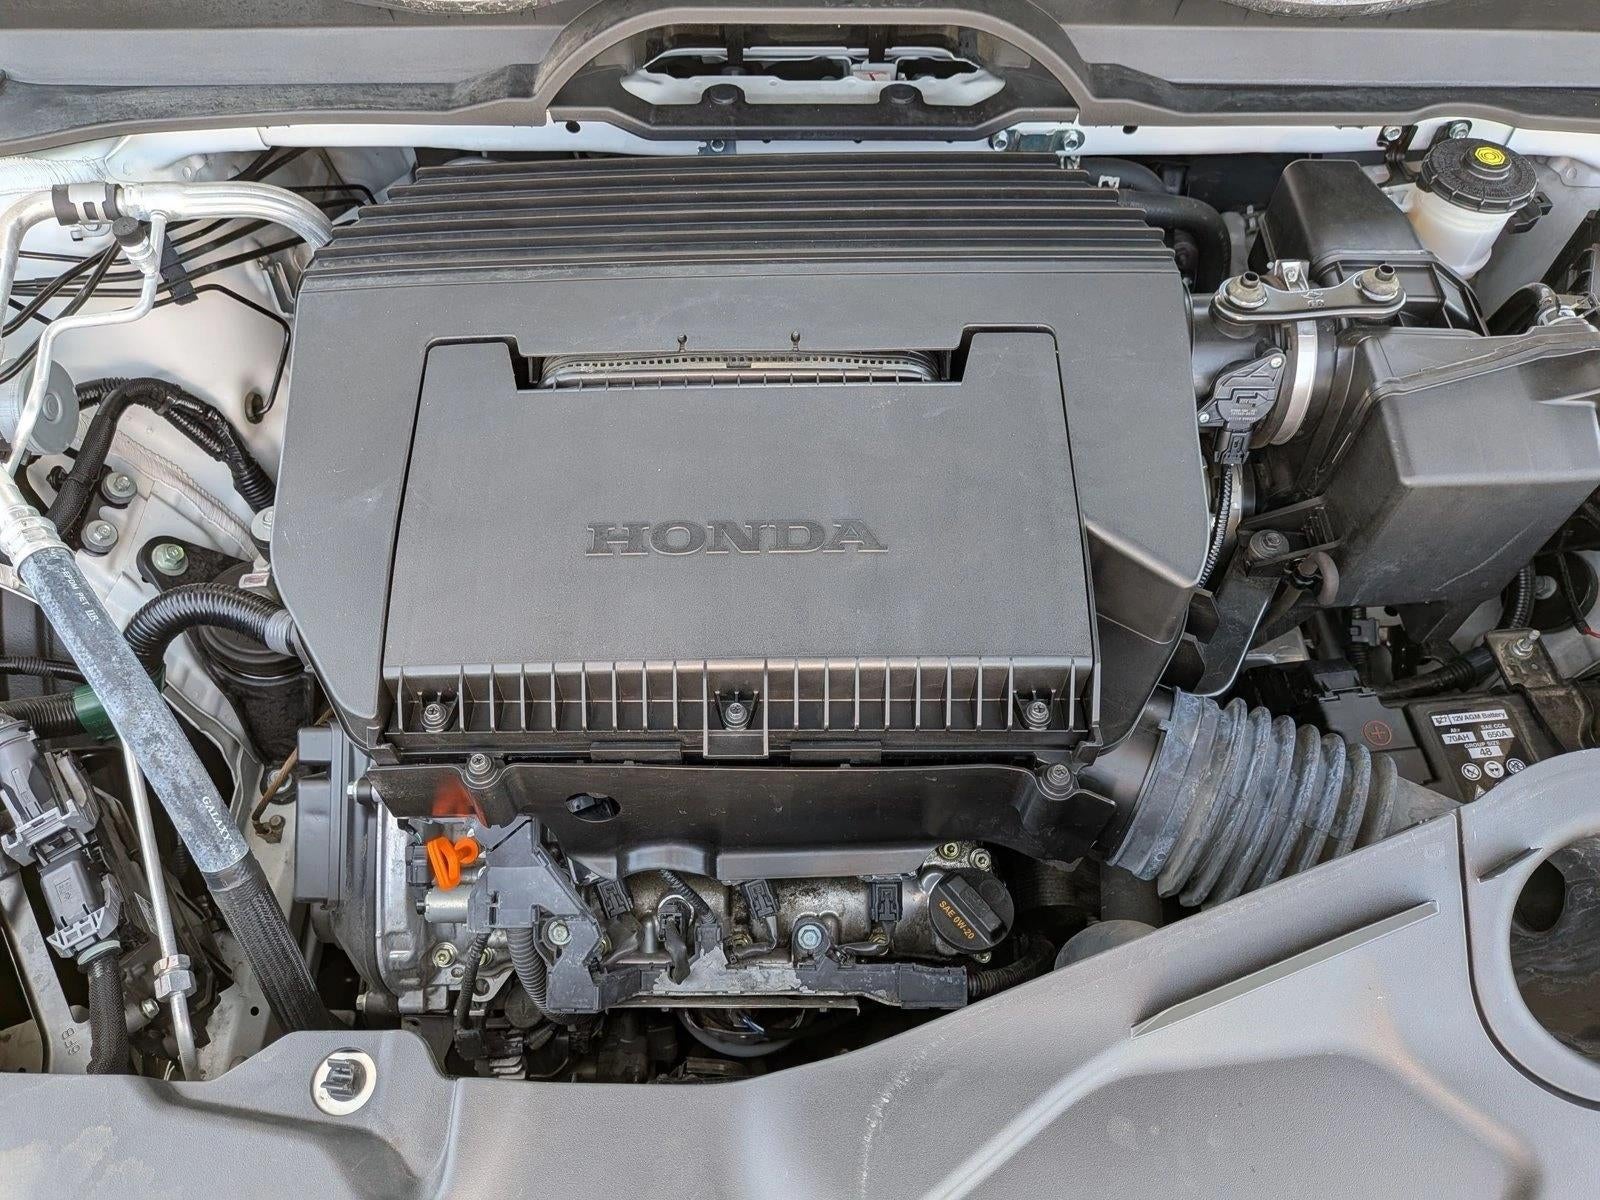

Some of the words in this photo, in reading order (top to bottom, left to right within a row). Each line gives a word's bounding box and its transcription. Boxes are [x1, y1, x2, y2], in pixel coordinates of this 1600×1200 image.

[586, 519, 889, 556] HONDA
[1447, 734, 1470, 742] 70AH
[1480, 748, 1492, 756] 48
[202, 795, 233, 841] GALAXY
[939, 900, 956, 918] SAE
[953, 916, 975, 940] 0W-20
